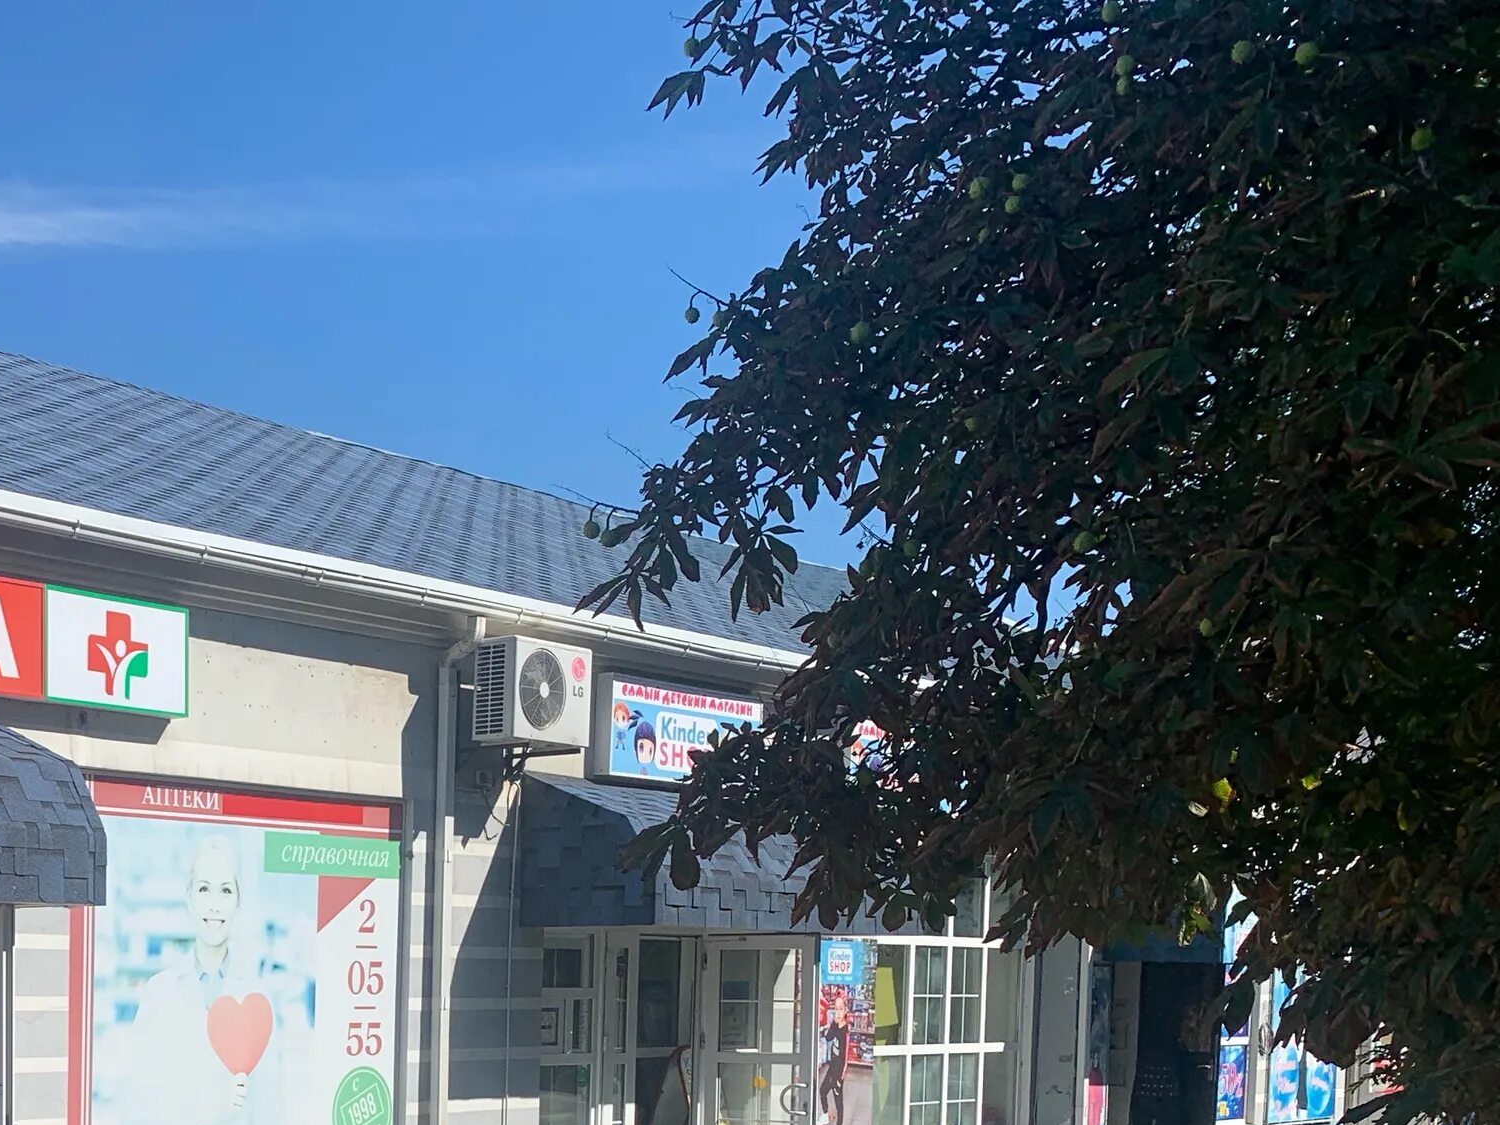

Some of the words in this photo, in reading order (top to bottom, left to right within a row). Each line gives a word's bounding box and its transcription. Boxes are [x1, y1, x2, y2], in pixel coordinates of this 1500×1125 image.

[572, 685, 584, 697] LG
[708, 698, 753, 717] МАГАЗИН
[661, 716, 709, 745] Kinde
[141, 786, 220, 811] АПТЕКИ
[281, 842, 390, 870] справочная
[357, 899, 376, 934] 2
[347, 960, 384, 996] 05
[830, 961, 851, 973] SHOP
[346, 1022, 382, 1057] 55
